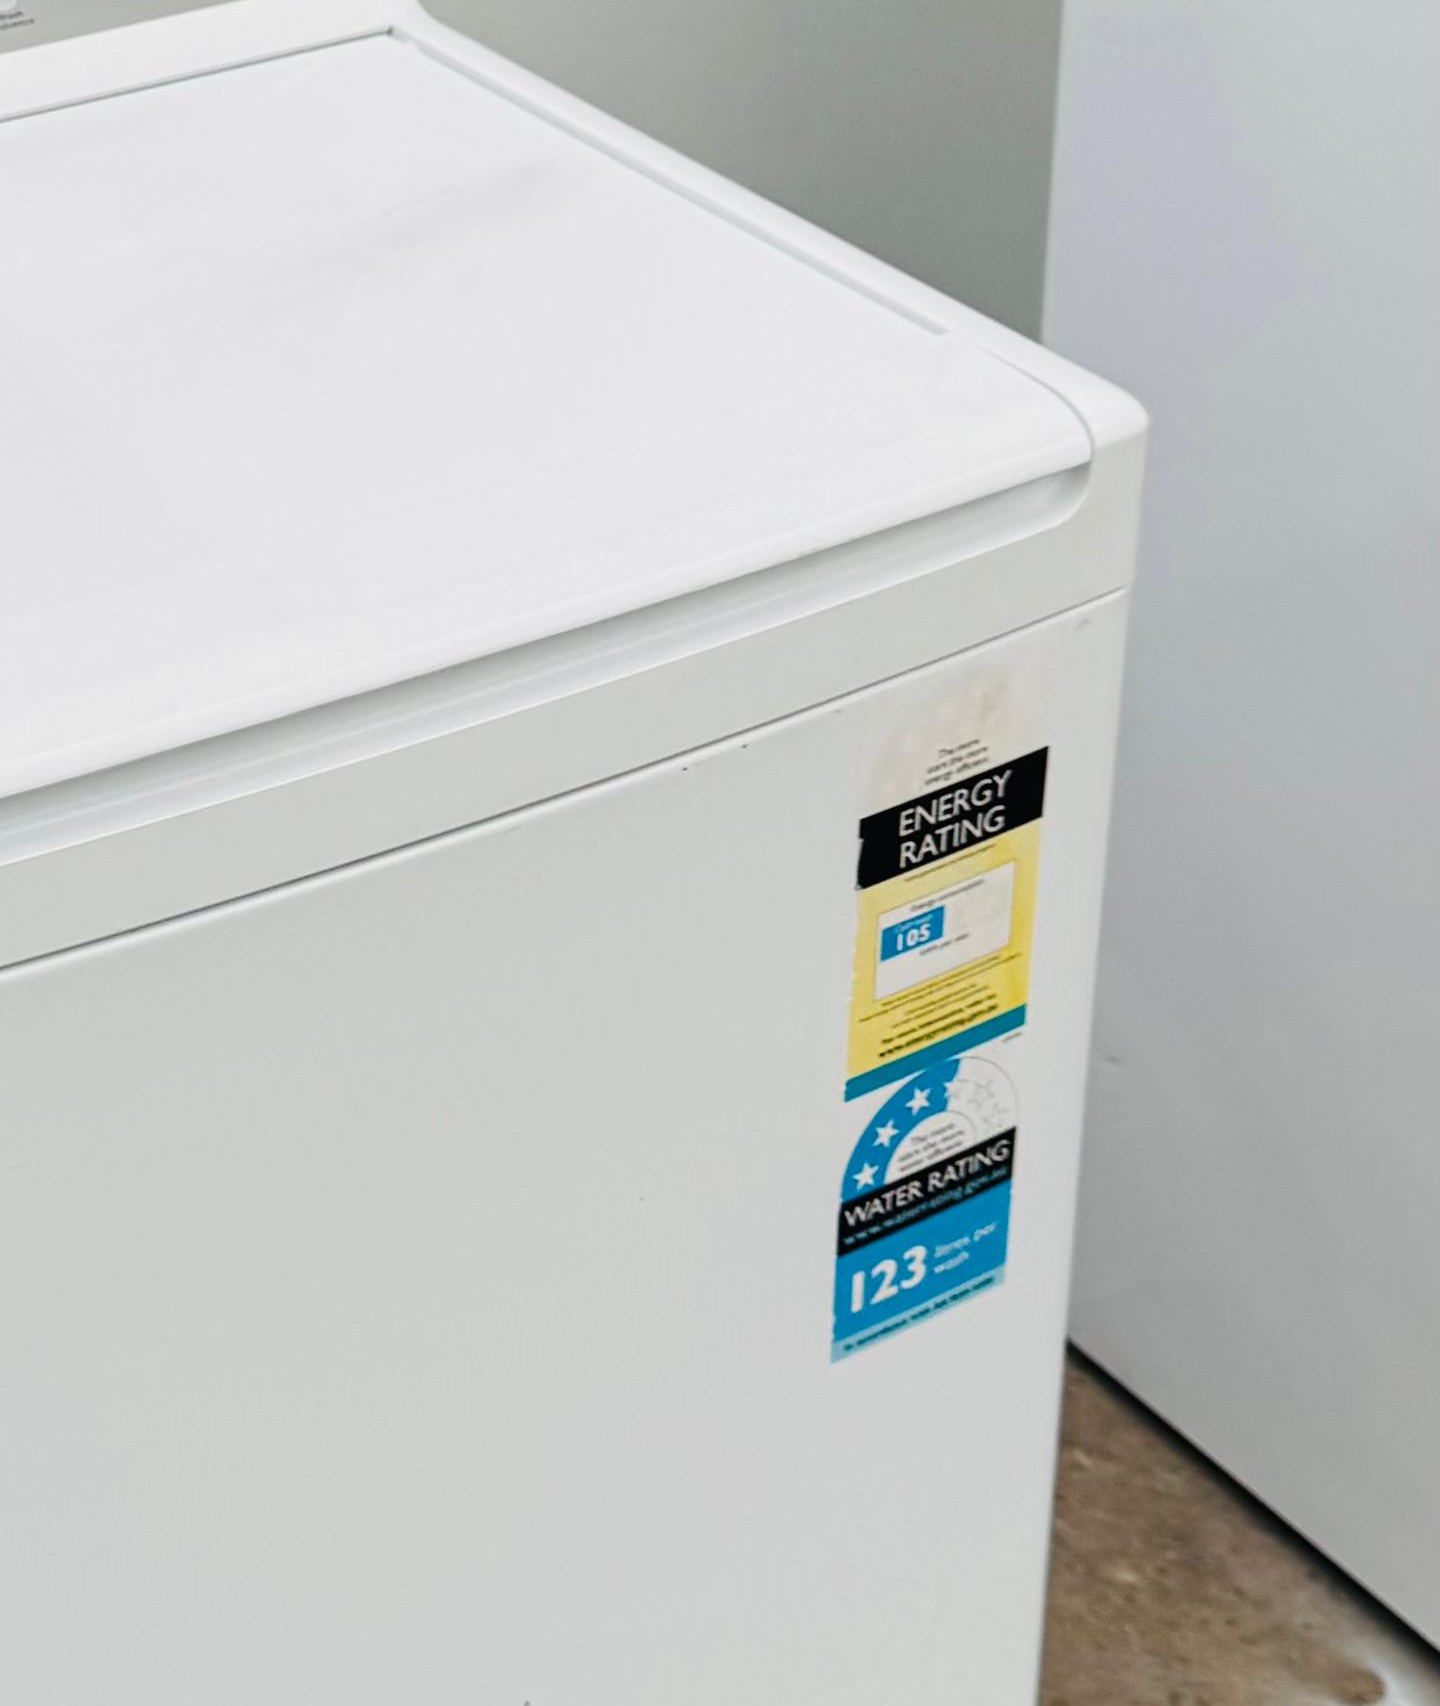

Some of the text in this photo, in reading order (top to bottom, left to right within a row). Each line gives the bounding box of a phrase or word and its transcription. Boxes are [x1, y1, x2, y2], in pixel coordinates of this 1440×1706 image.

[898, 769, 1012, 837] ENERGY
[899, 804, 1006, 868] RATING
[844, 1139, 1009, 1227] WATER RATING
[850, 1244, 928, 1314] 123
